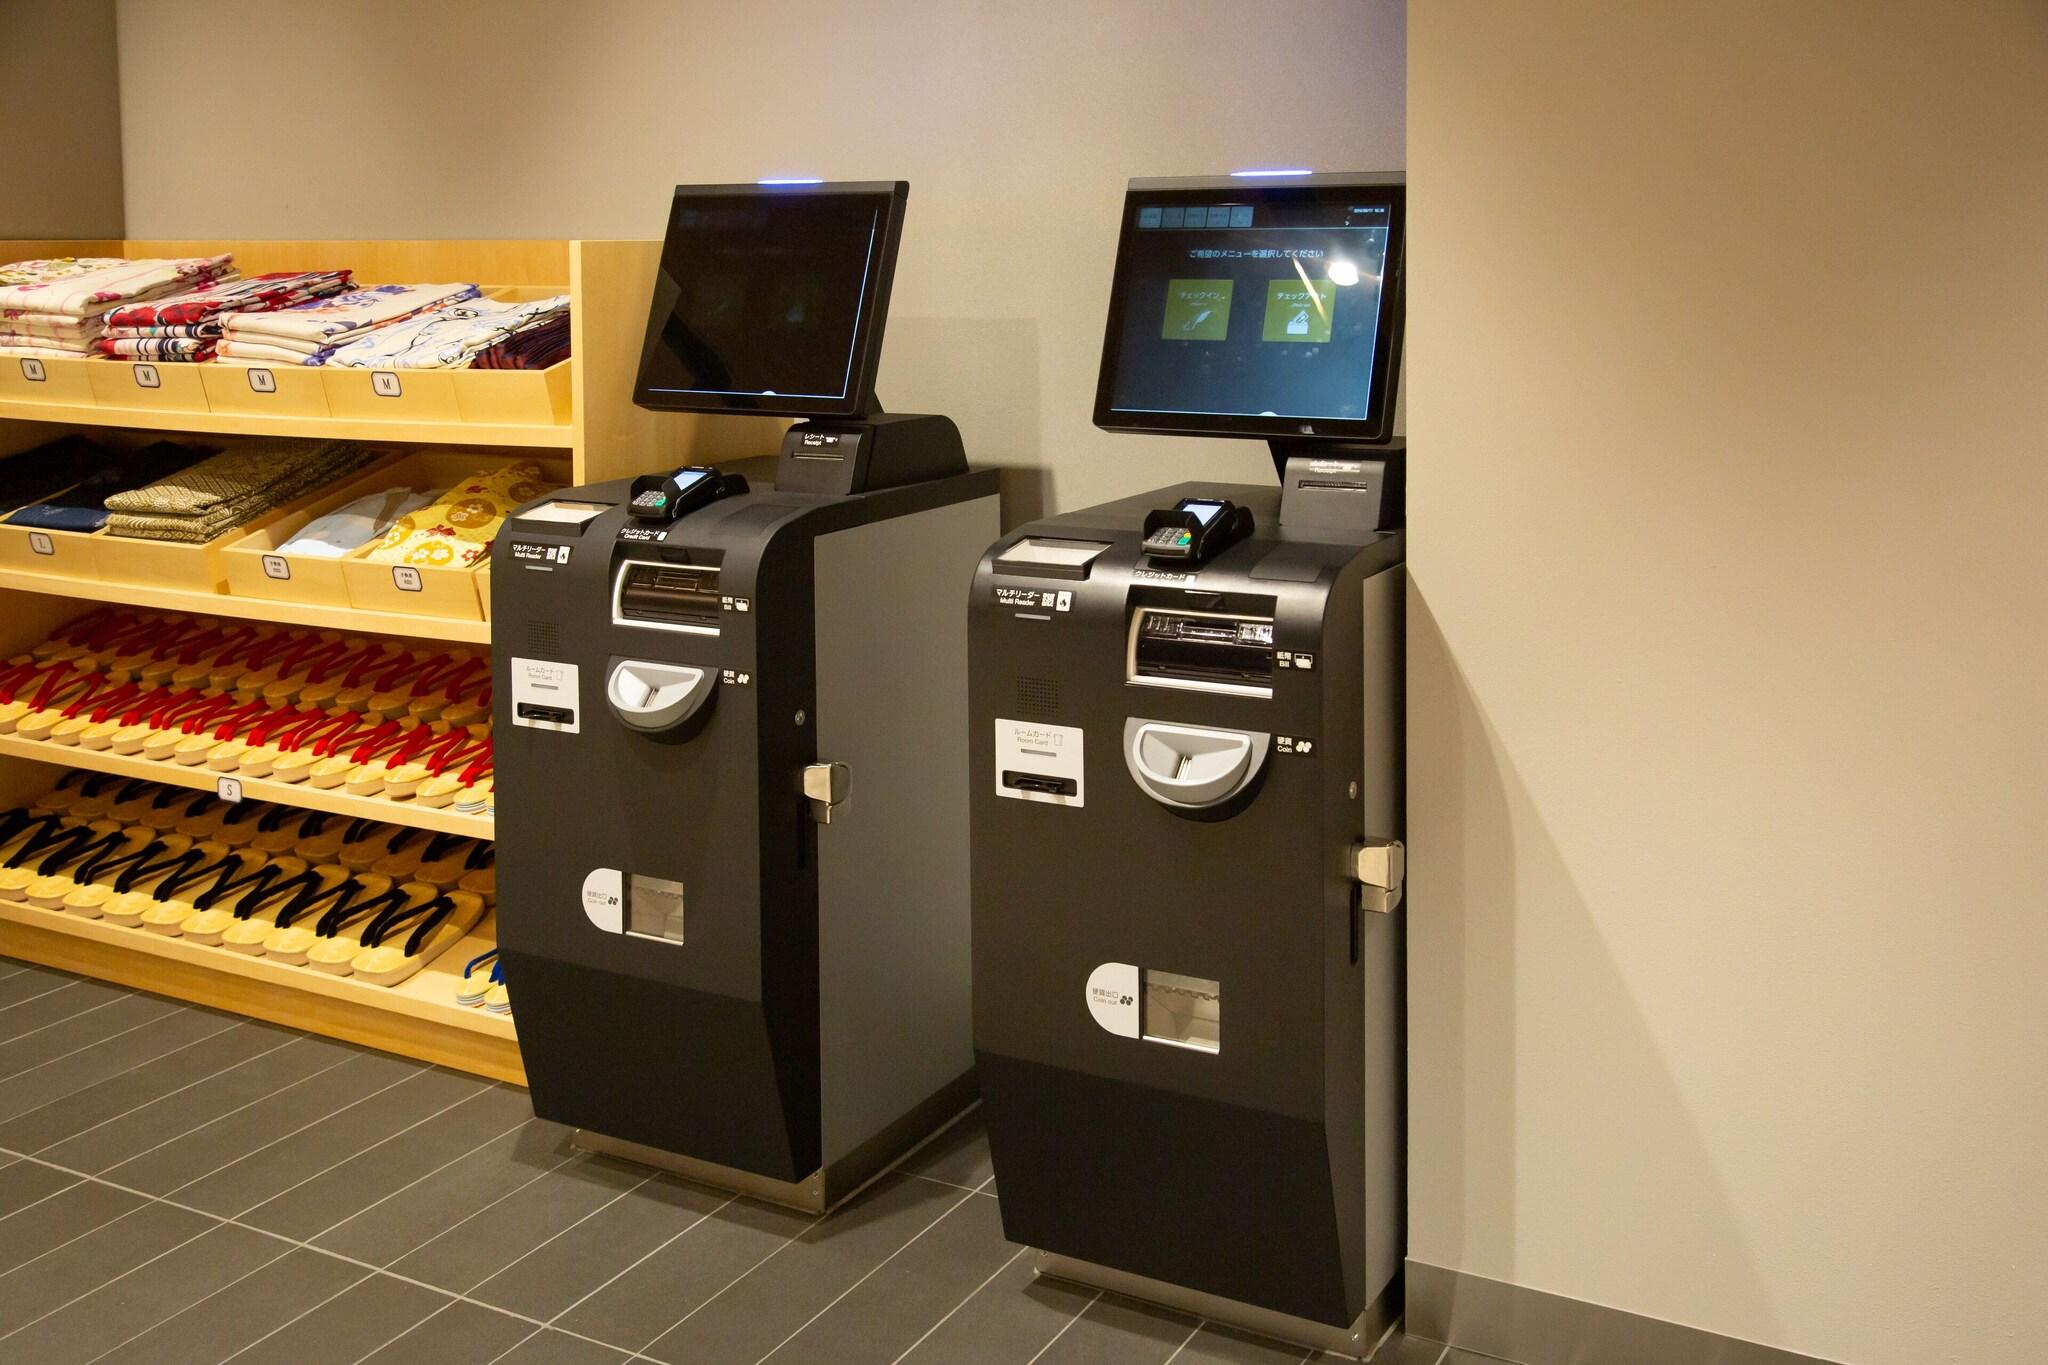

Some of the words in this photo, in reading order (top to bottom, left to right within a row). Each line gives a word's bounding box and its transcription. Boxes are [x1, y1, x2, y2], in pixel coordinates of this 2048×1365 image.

[1189, 249, 1324, 259] ご希望のメニューを選択してください
[1277, 292, 1328, 300] チェックアト
[29, 363, 38, 375] M
[142, 370, 152, 381] M
[257, 374, 266, 386] M
[382, 378, 392, 390] M
[621, 528, 660, 536] クレジットカード
[513, 544, 546, 553] マルチリーダー
[1135, 570, 1186, 580] クレジットカード
[996, 588, 1041, 599] マルチリーダー
[1000, 597, 1014, 605] Multi
[1014, 598, 1036, 606] Reader
[723, 677, 735, 685] Coin
[1014, 727, 1051, 739] ルームカード
[1017, 736, 1034, 744] Room
[1034, 738, 1049, 746] Card
[1277, 745, 1293, 753] Coin
[227, 783, 233, 796] S
[1093, 996, 1107, 1004] Coin
[1107, 998, 1118, 1006] out
